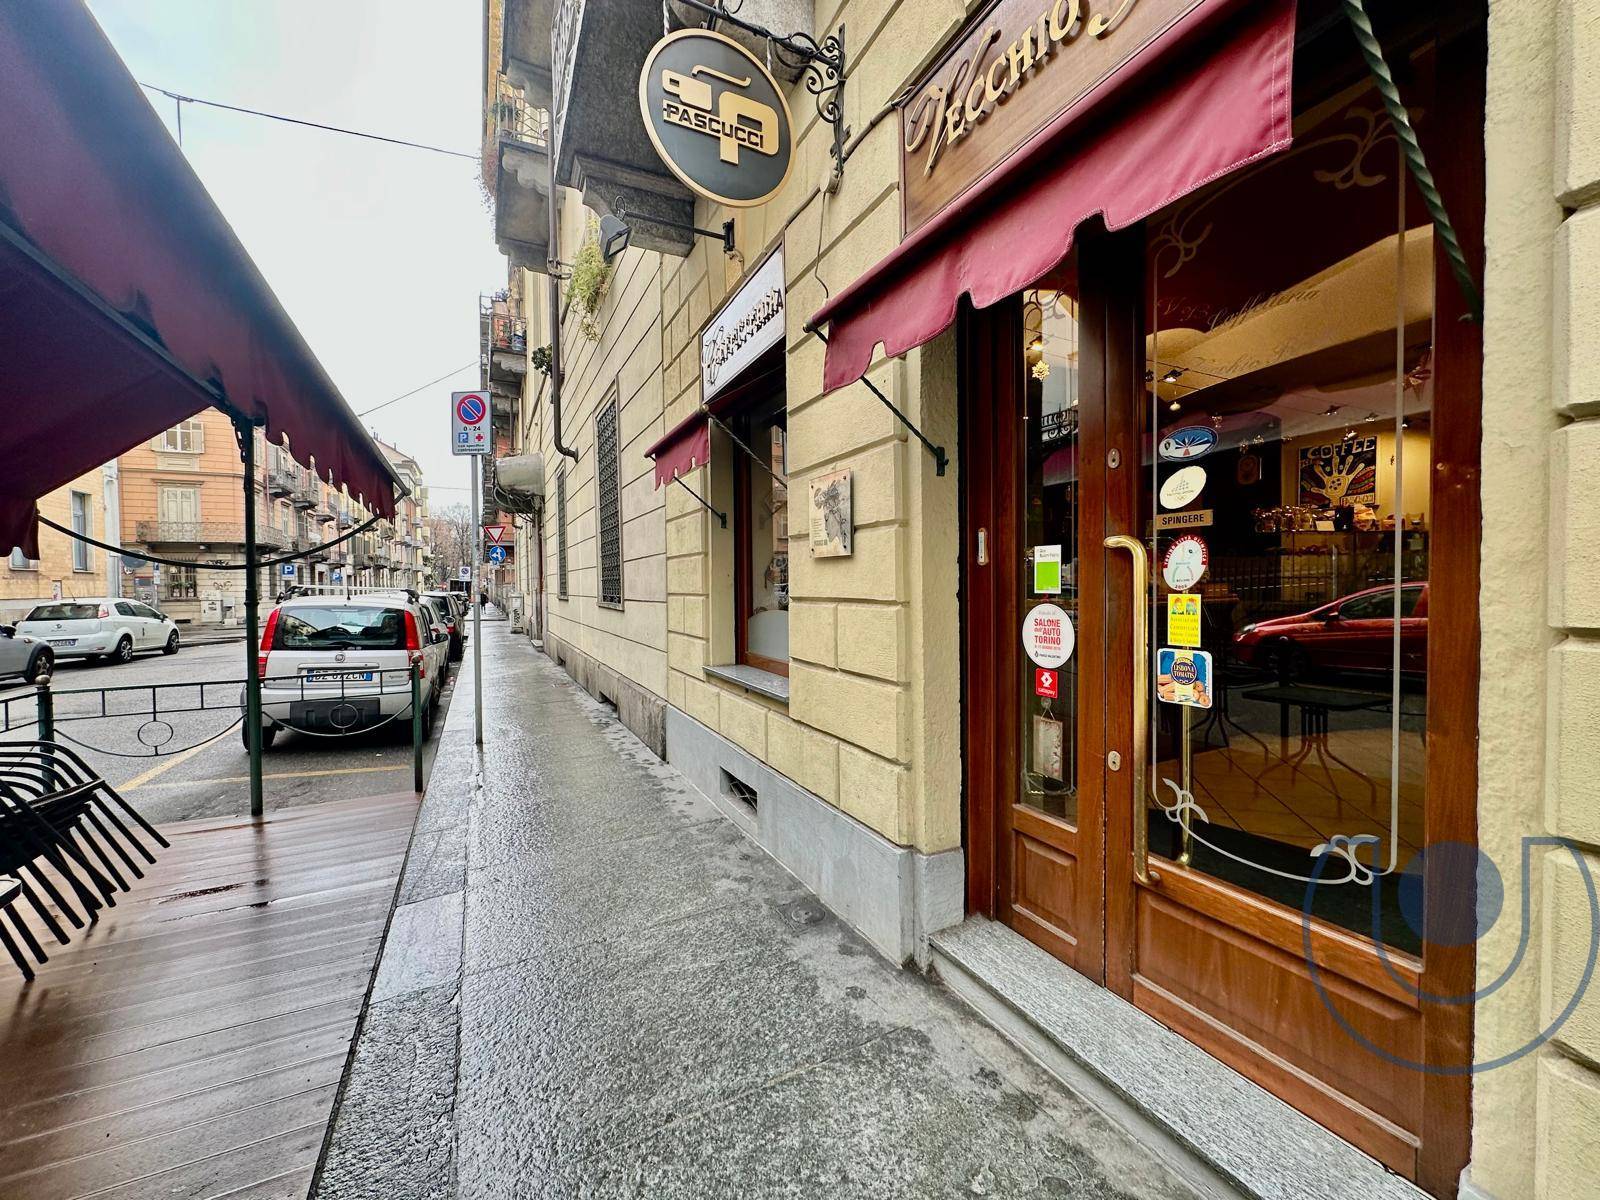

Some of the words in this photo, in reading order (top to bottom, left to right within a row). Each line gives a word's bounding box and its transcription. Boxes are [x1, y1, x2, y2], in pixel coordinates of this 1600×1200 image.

[905, 0, 1081, 176] VECCHIO
[664, 104, 764, 149] PASCUCCI
[1307, 436, 1377, 459] COFFEE
[1161, 513, 1205, 526] SPINGERE
[1034, 618, 1061, 628] SALONE
[1034, 635, 1061, 646] TORINO
